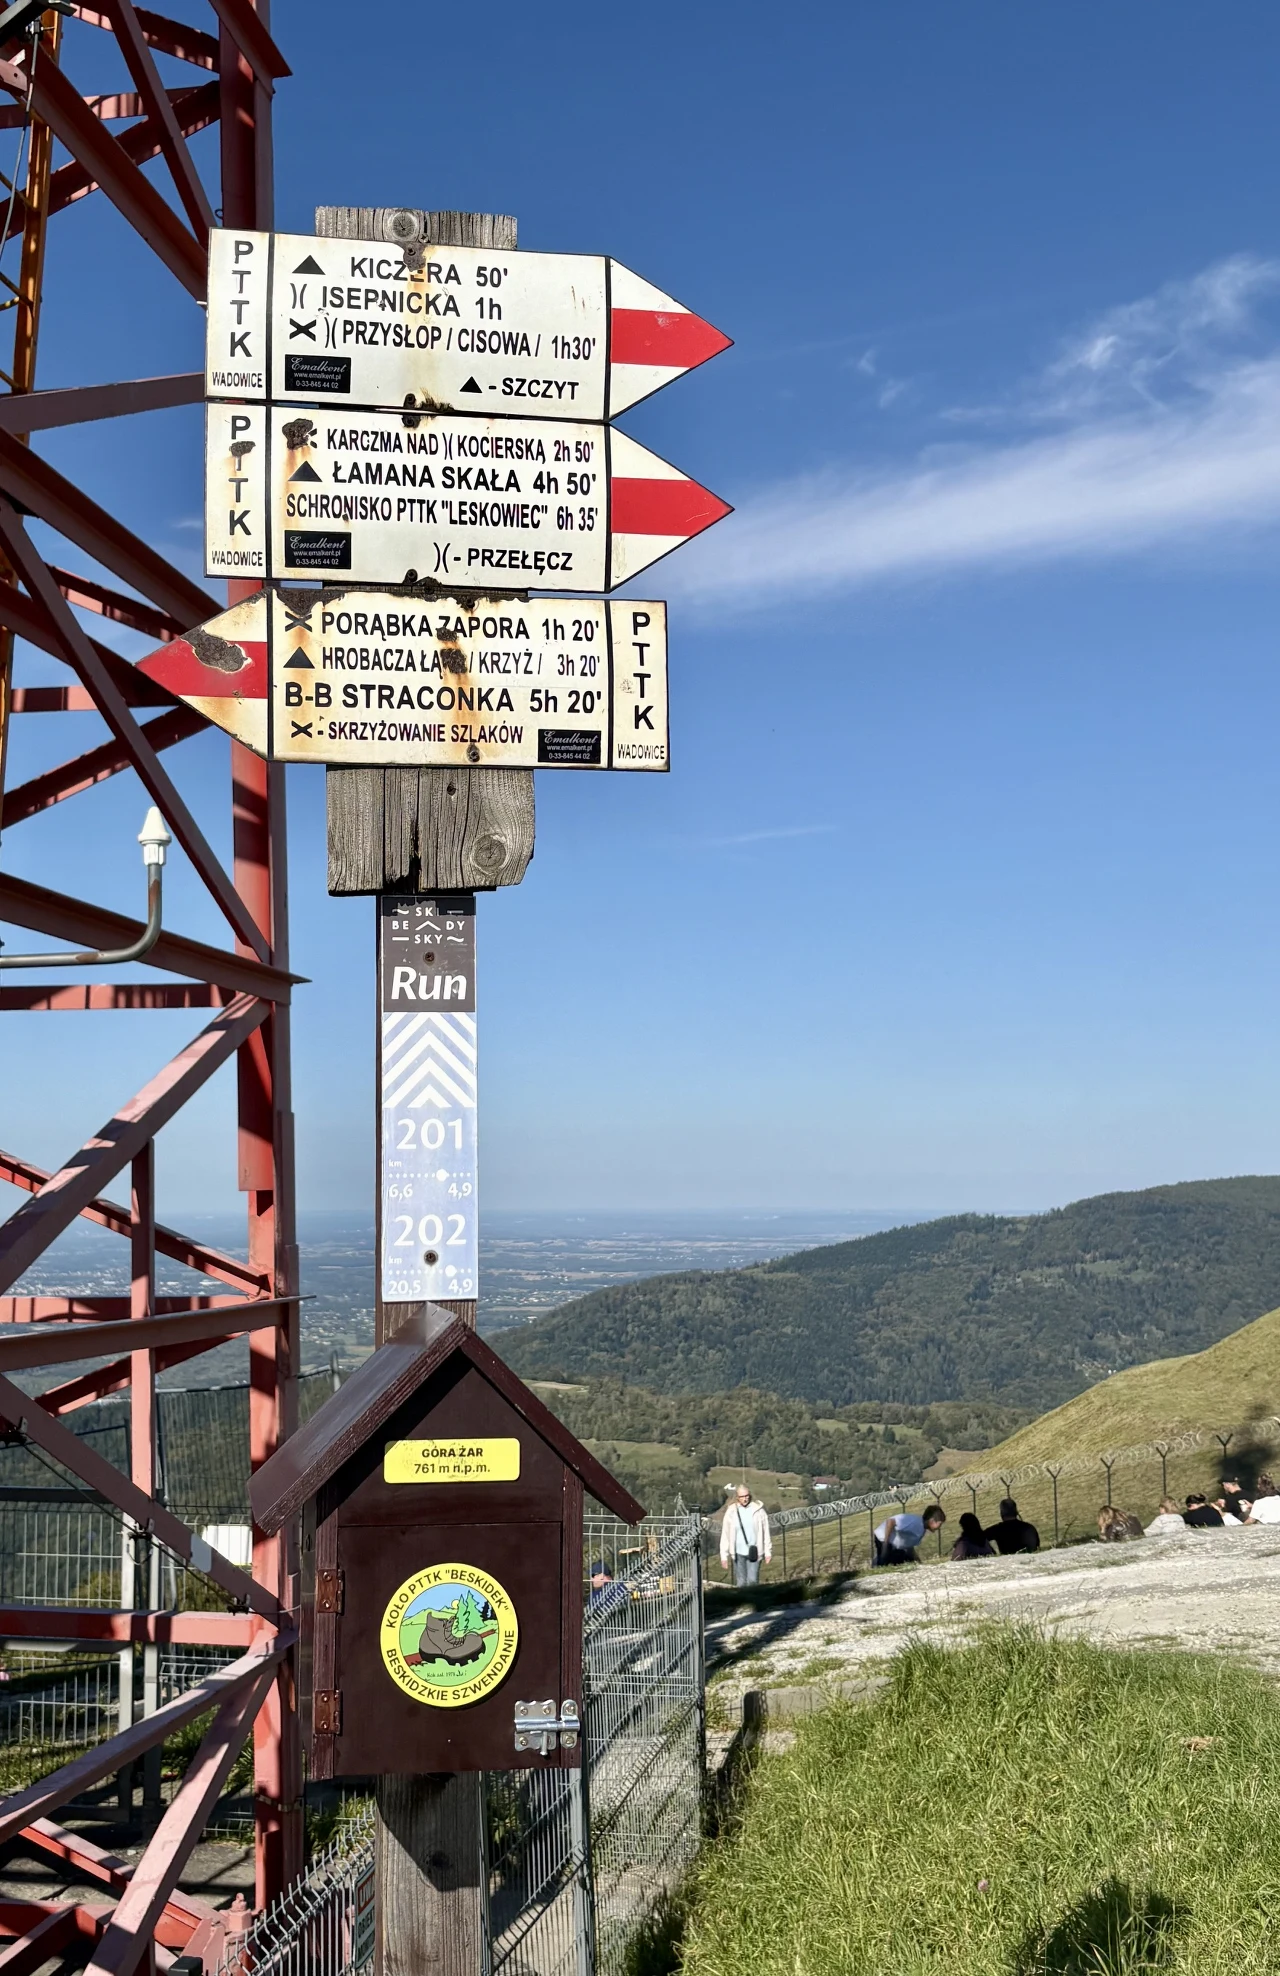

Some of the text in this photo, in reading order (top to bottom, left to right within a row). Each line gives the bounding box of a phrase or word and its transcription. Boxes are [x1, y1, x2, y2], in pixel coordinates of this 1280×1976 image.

[476, 266, 508, 288] 50'
[229, 240, 254, 358] PTTK
[322, 286, 502, 320] ISEPNICKA 1h
[343, 319, 441, 349] PRZYSŁOP
[551, 335, 596, 360] 1h30'
[291, 356, 347, 373] Emalkent
[212, 371, 263, 388] WADOWICE
[293, 372, 341, 381] www.emalkent.pl
[295, 380, 321, 388] 0-33-845
[501, 377, 579, 400] SZCZYT
[327, 428, 594, 464] KARCZMA NAD KOCIERSKĄ 2h 50'
[332, 460, 596, 496] ŁAMANA SKAŁA 4h 50'
[286, 493, 598, 531] SCHRONISKO PTTK "LESKOWIEC" 6h 35'
[290, 535, 346, 549] Emalkent
[293, 549, 341, 557] www.emalkent.pl
[212, 550, 263, 567] WADOWICE
[467, 547, 573, 576] PRZEŁĘCZ
[322, 611, 433, 641] PORĄBKA
[542, 618, 565, 641] 1h
[572, 619, 599, 642] 20'
[322, 646, 416, 672] HROBACZA
[479, 649, 533, 675] KRZYŻ
[557, 653, 575, 677] 3h
[580, 655, 600, 677] 20'
[632, 611, 655, 730] PTTK
[285, 681, 602, 714] B-B STRACONKA 5h 20'
[328, 720, 446, 742] SKRZYŻOWANIE
[451, 720, 523, 744] SZLAKÓW
[543, 730, 598, 744] Emalkent
[546, 744, 592, 752] www.emalkent.pl
[548, 752, 574, 760] 0-33-845
[617, 743, 665, 760] WADOWICE
[414, 934, 443, 944] SKY
[391, 966, 467, 1000] Run
[396, 1118, 463, 1150] 201
[388, 1159, 402, 1168] km
[388, 1182, 473, 1200] 6,6 4,9
[393, 1213, 467, 1247] 202
[388, 1256, 402, 1264] km
[388, 1278, 473, 1296] 20,5 4,9
[421, 1445, 483, 1458] GÓRA ŻAR
[414, 1463, 490, 1475] 761 m n.p.m.
[386, 1569, 509, 1628] KOŁO PTTK "BESKIDEK"
[386, 1630, 515, 1701] BESKIDZKIE SZWENDANIE
